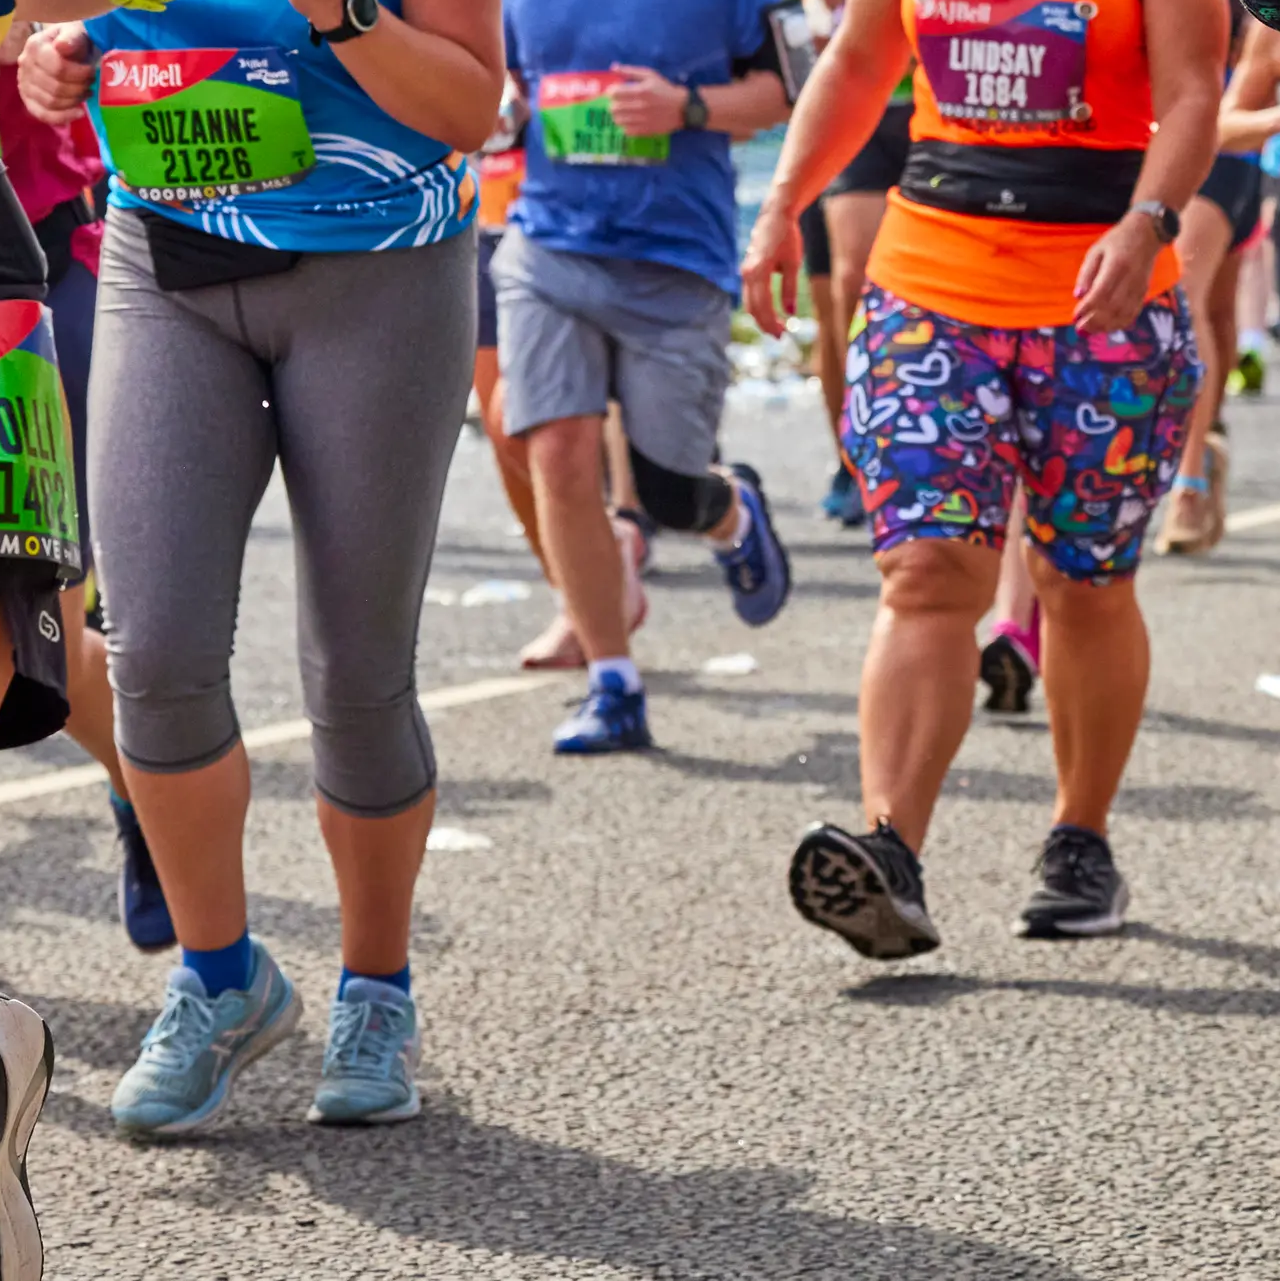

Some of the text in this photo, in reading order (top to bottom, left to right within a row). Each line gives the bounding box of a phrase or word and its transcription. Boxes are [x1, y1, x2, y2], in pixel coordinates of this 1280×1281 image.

[949, 37, 1046, 78] LINDSAY
[124, 63, 183, 92] AJBell
[964, 73, 1028, 108] 1684
[142, 108, 261, 145] SUZANNE
[162, 147, 252, 184] 21226
[138, 185, 242, 202] GOODMOVE
